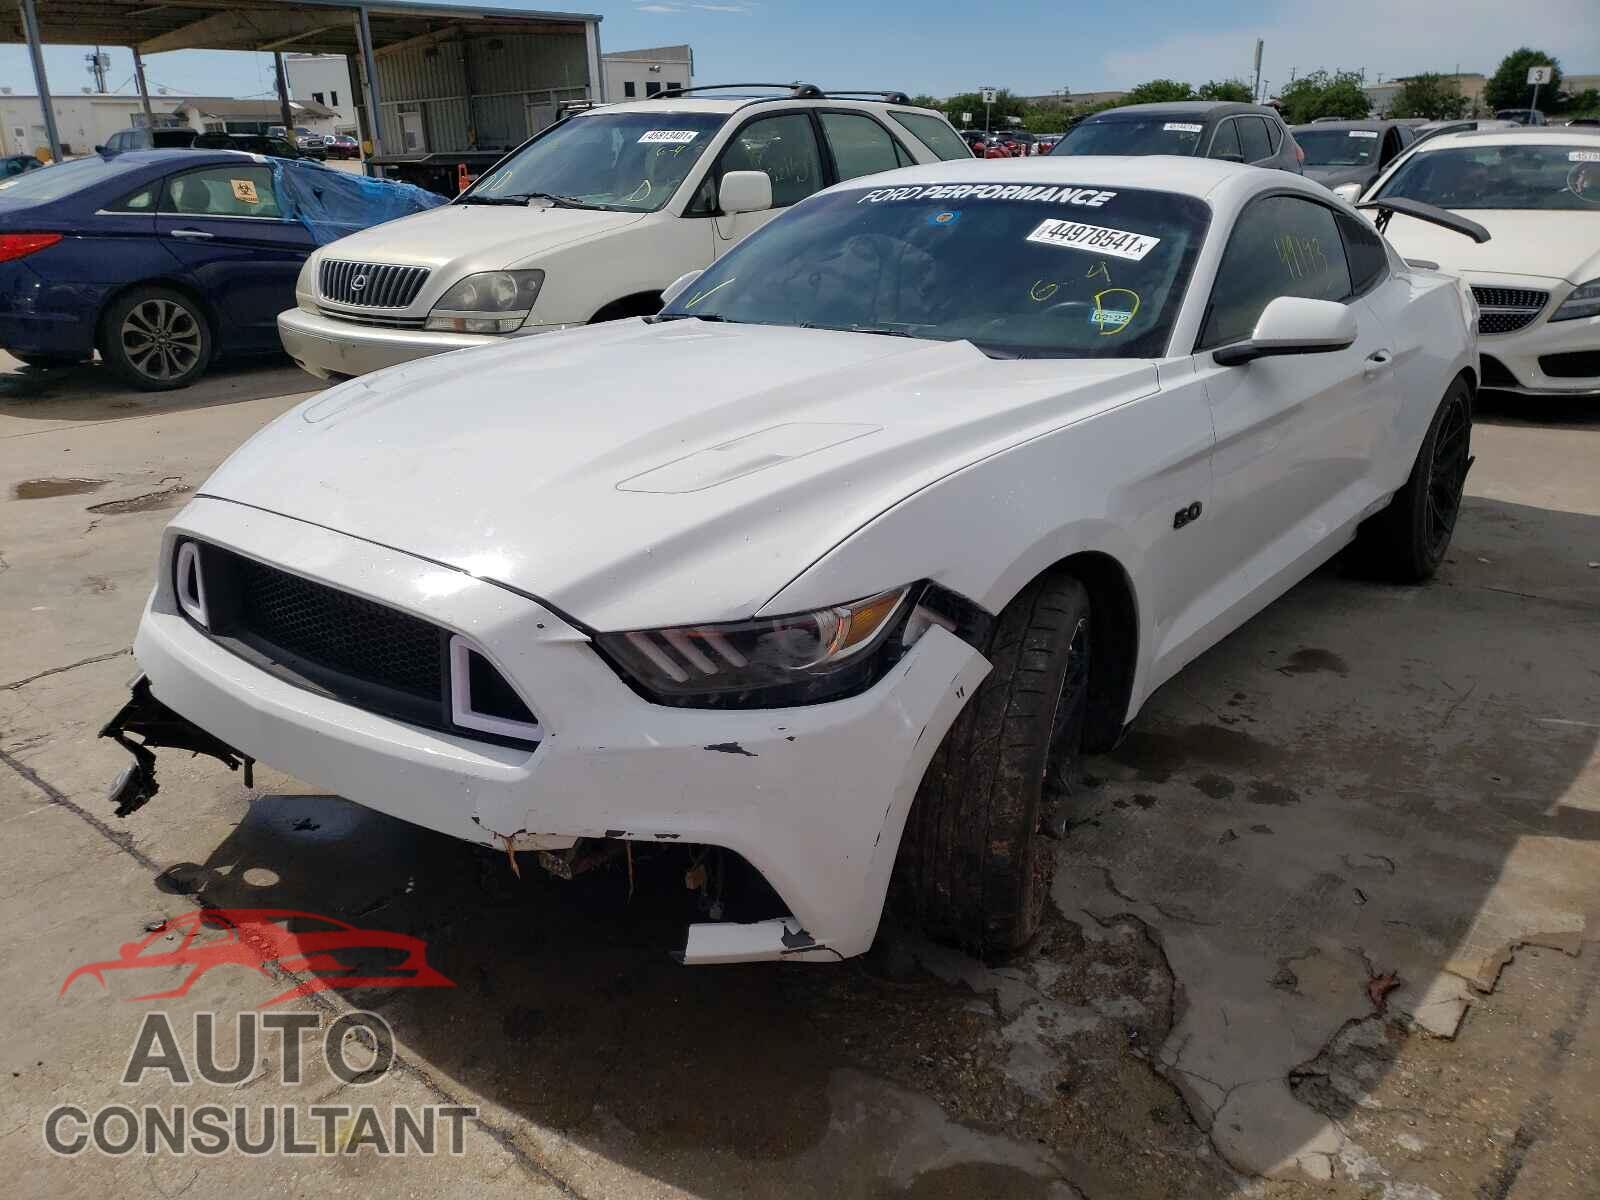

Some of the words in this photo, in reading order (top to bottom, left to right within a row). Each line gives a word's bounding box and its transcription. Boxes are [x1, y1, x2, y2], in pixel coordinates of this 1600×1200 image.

[1535, 70, 1543, 81] 3
[857, 187, 921, 204] FORD
[919, 184, 1118, 207] PERFORMANCE
[1048, 222, 1141, 252] 44978541
